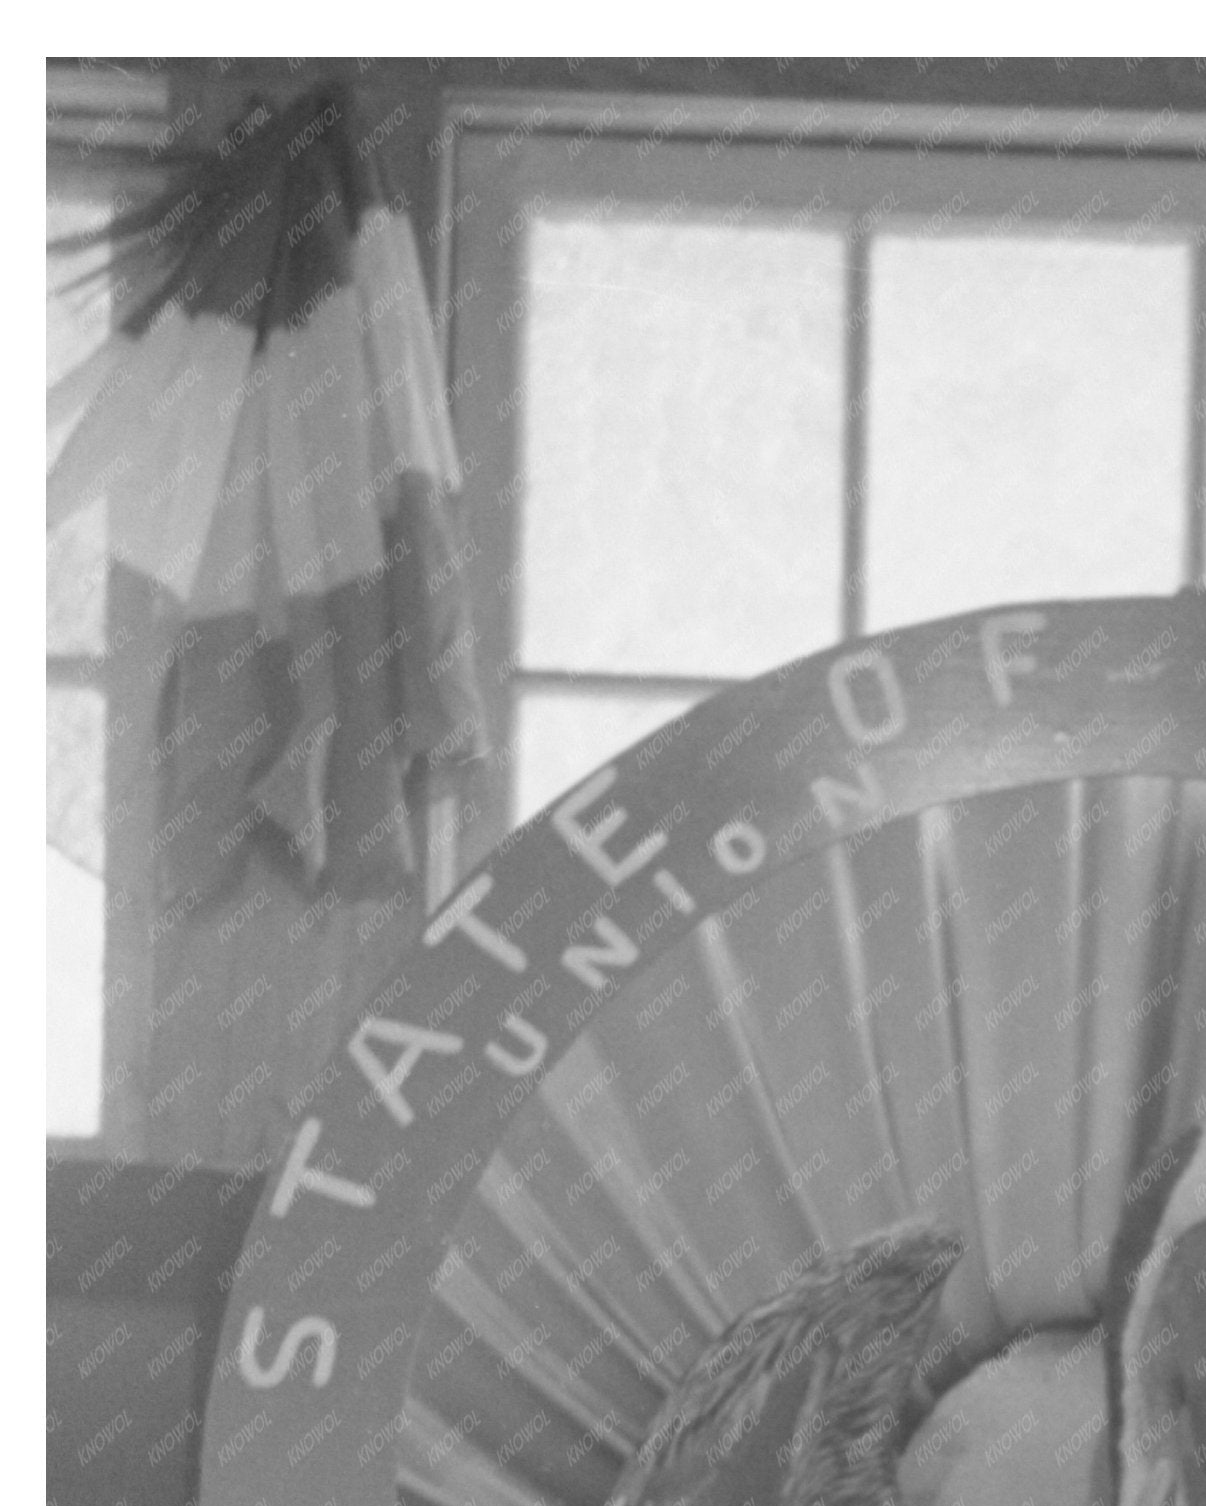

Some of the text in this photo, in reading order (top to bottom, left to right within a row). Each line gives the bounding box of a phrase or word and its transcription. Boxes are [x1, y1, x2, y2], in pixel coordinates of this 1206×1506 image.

[237, 764, 668, 1388] STATE
[827, 611, 1048, 747] OF
[484, 762, 885, 1077] UNION
